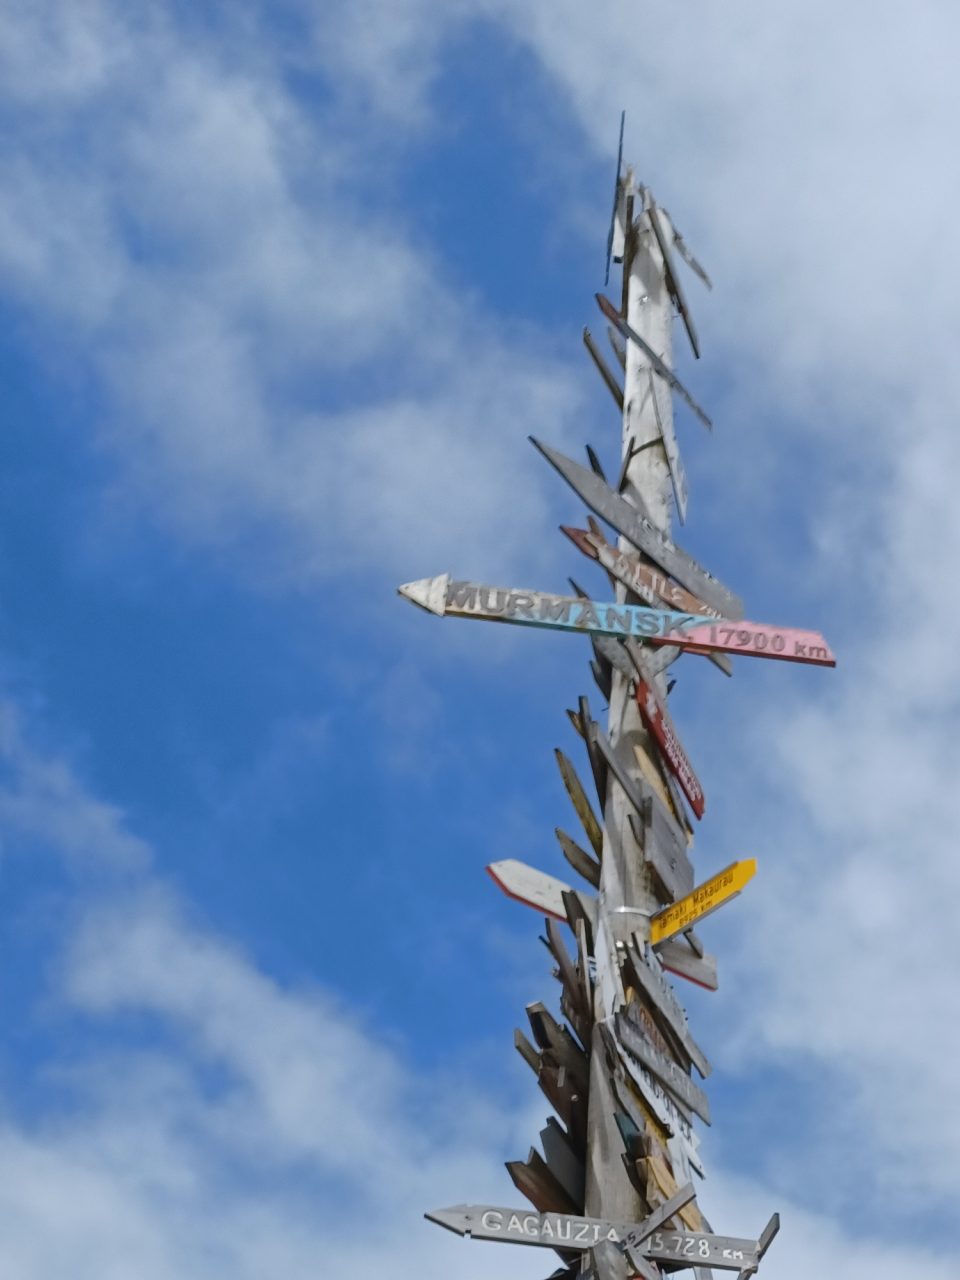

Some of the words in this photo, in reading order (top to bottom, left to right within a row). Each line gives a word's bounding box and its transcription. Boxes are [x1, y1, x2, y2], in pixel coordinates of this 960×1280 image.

[708, 626, 785, 653] 17900
[794, 640, 828, 659] km
[480, 1209, 620, 1244] GAGAUZIA
